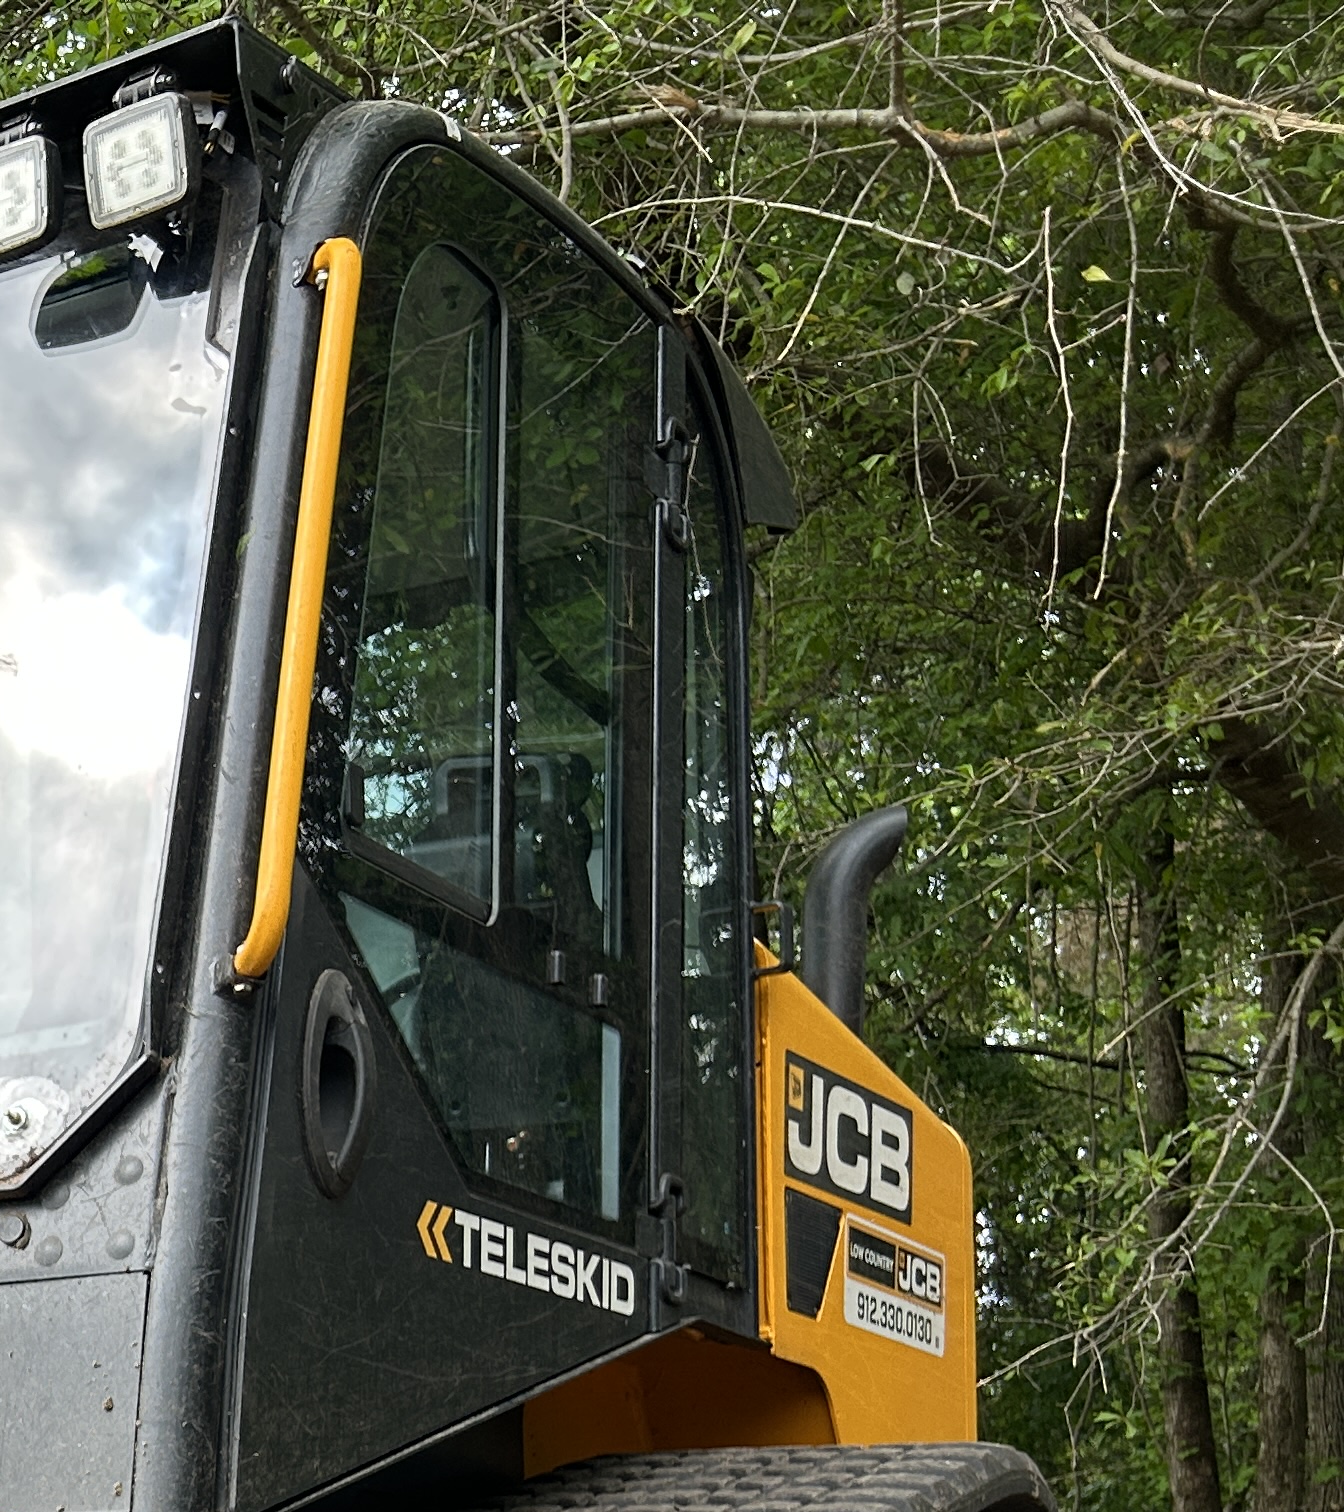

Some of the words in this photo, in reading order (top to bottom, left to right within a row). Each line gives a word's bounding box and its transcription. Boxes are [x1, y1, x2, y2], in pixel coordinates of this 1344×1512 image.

[788, 1073, 910, 1212] JCB
[454, 1207, 636, 1317] TELESKID
[850, 1241, 865, 1261] LOW
[864, 1247, 894, 1274] COUNTRY
[898, 1253, 941, 1304] JCB
[857, 1290, 933, 1346] 912.330.0130
